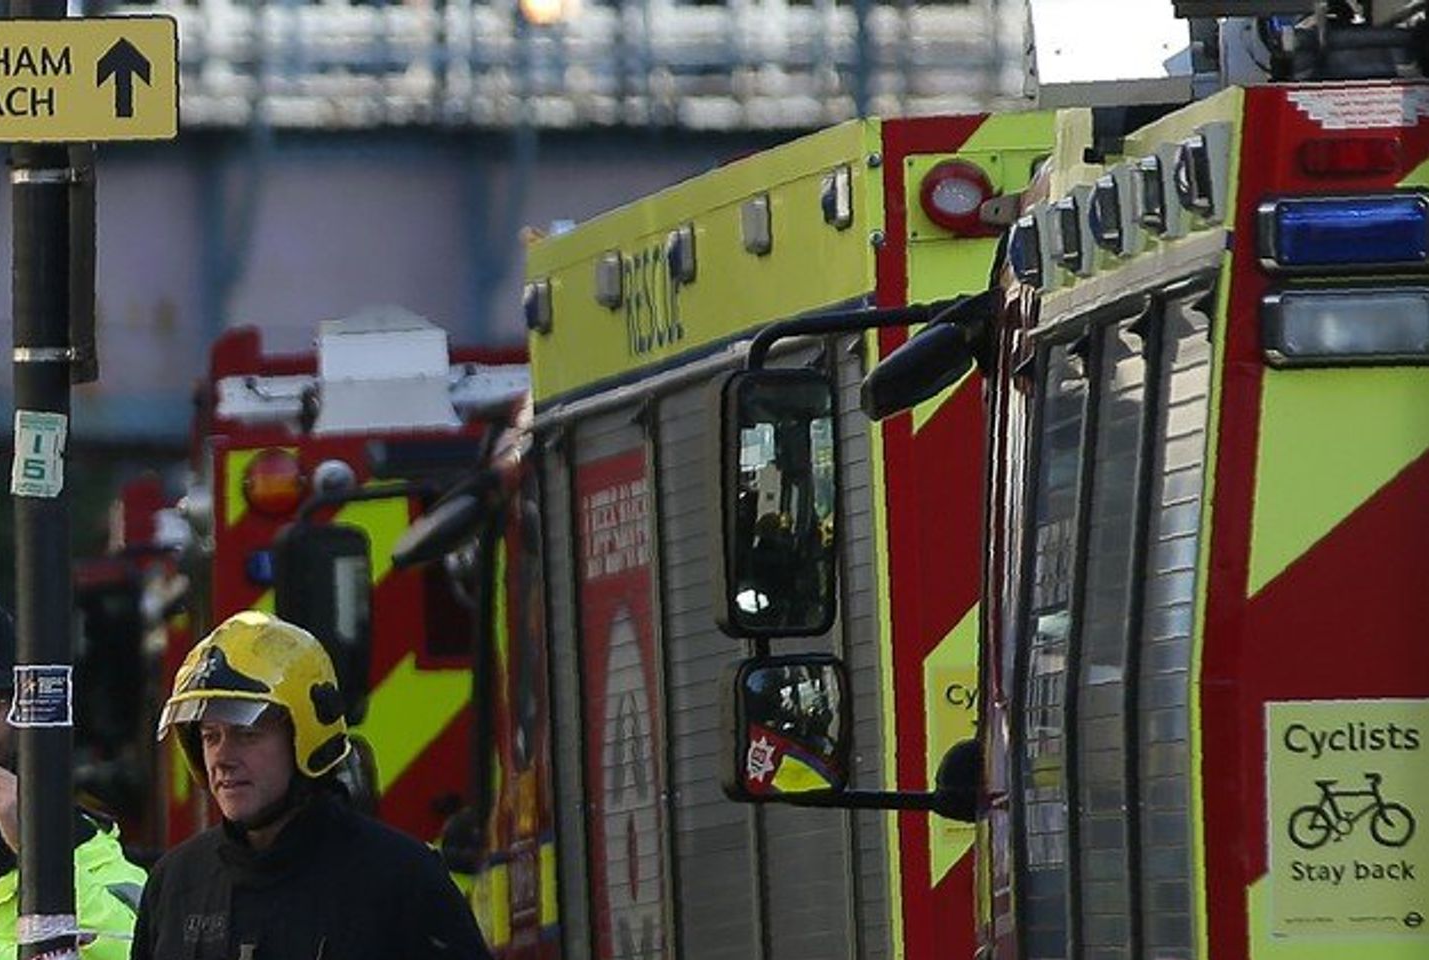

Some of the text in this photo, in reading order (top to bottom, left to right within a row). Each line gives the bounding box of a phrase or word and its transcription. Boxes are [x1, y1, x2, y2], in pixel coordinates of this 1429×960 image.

[1284, 722, 1420, 760] Cyclists
[1290, 859, 1417, 886] Stay back
